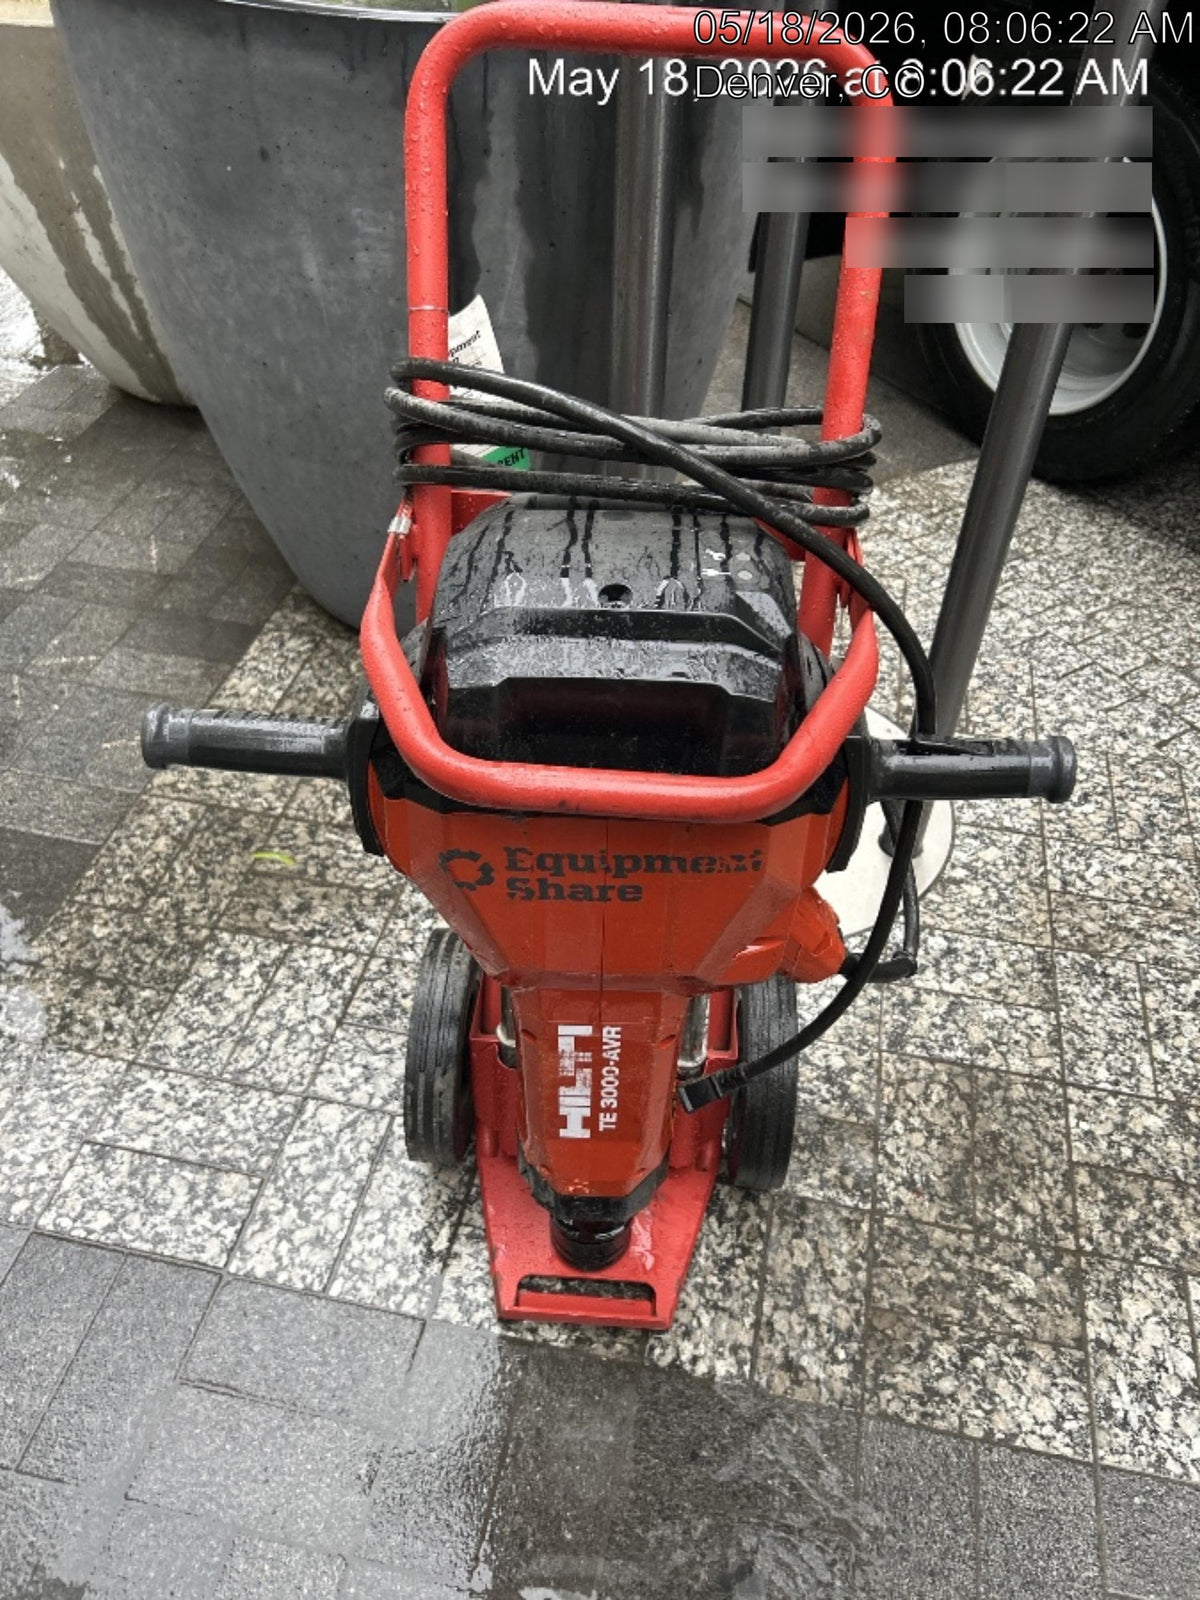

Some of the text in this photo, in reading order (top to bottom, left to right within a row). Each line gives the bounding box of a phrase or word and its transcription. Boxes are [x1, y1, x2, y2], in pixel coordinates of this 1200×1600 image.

[503, 846, 764, 879] Equipment
[506, 877, 644, 903] Share
[557, 1024, 593, 1139] HILTI
[598, 1025, 622, 1132] TE 3000-AVR
